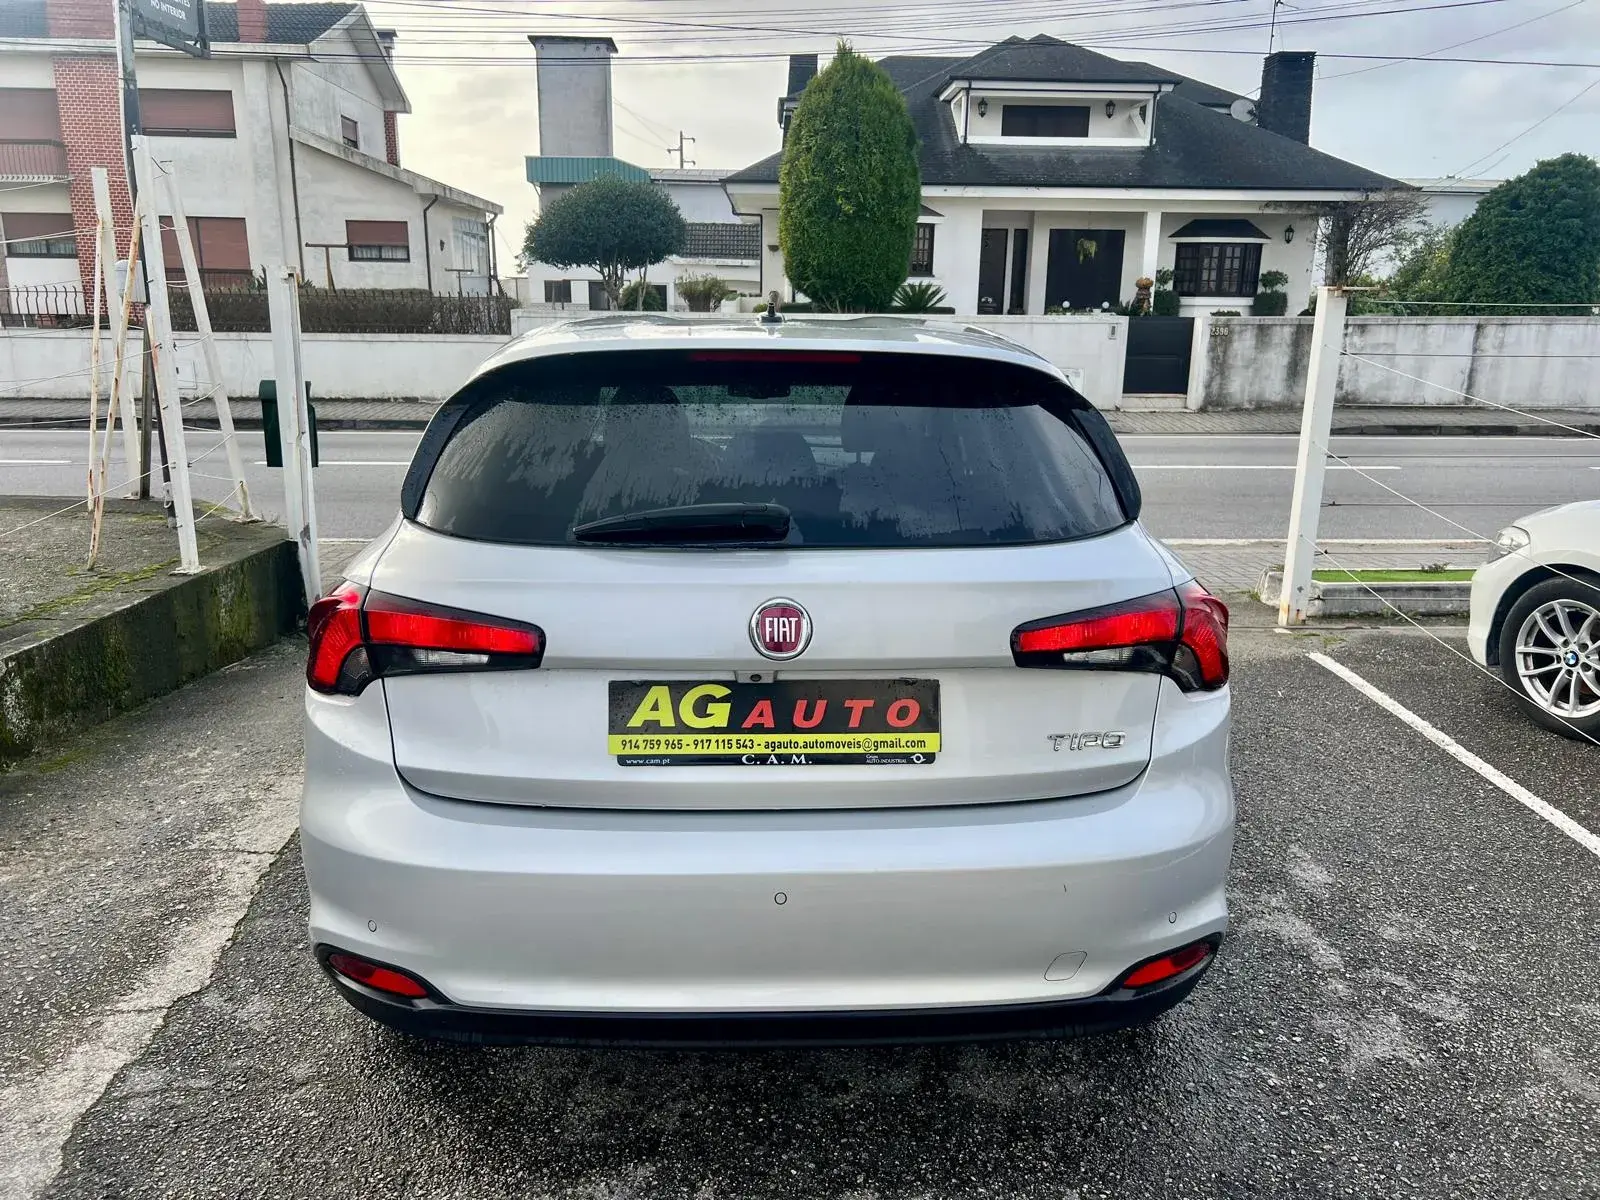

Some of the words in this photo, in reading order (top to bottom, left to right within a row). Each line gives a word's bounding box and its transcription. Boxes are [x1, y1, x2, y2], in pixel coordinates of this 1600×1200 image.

[151, 0, 160, 9] NO
[160, 1, 187, 20] INTERIOR
[765, 617, 799, 643] FIAT
[626, 683, 733, 729] AG
[741, 698, 921, 729] AUTO
[621, 738, 640, 750] 914
[643, 738, 662, 750] 759
[664, 738, 683, 750] 965
[693, 738, 712, 750] 917
[714, 738, 733, 750] 115
[735, 738, 755, 750] 543
[764, 737, 926, 752] agauto.automoveis@gmail.com
[1046, 731, 1127, 752] TIPO
